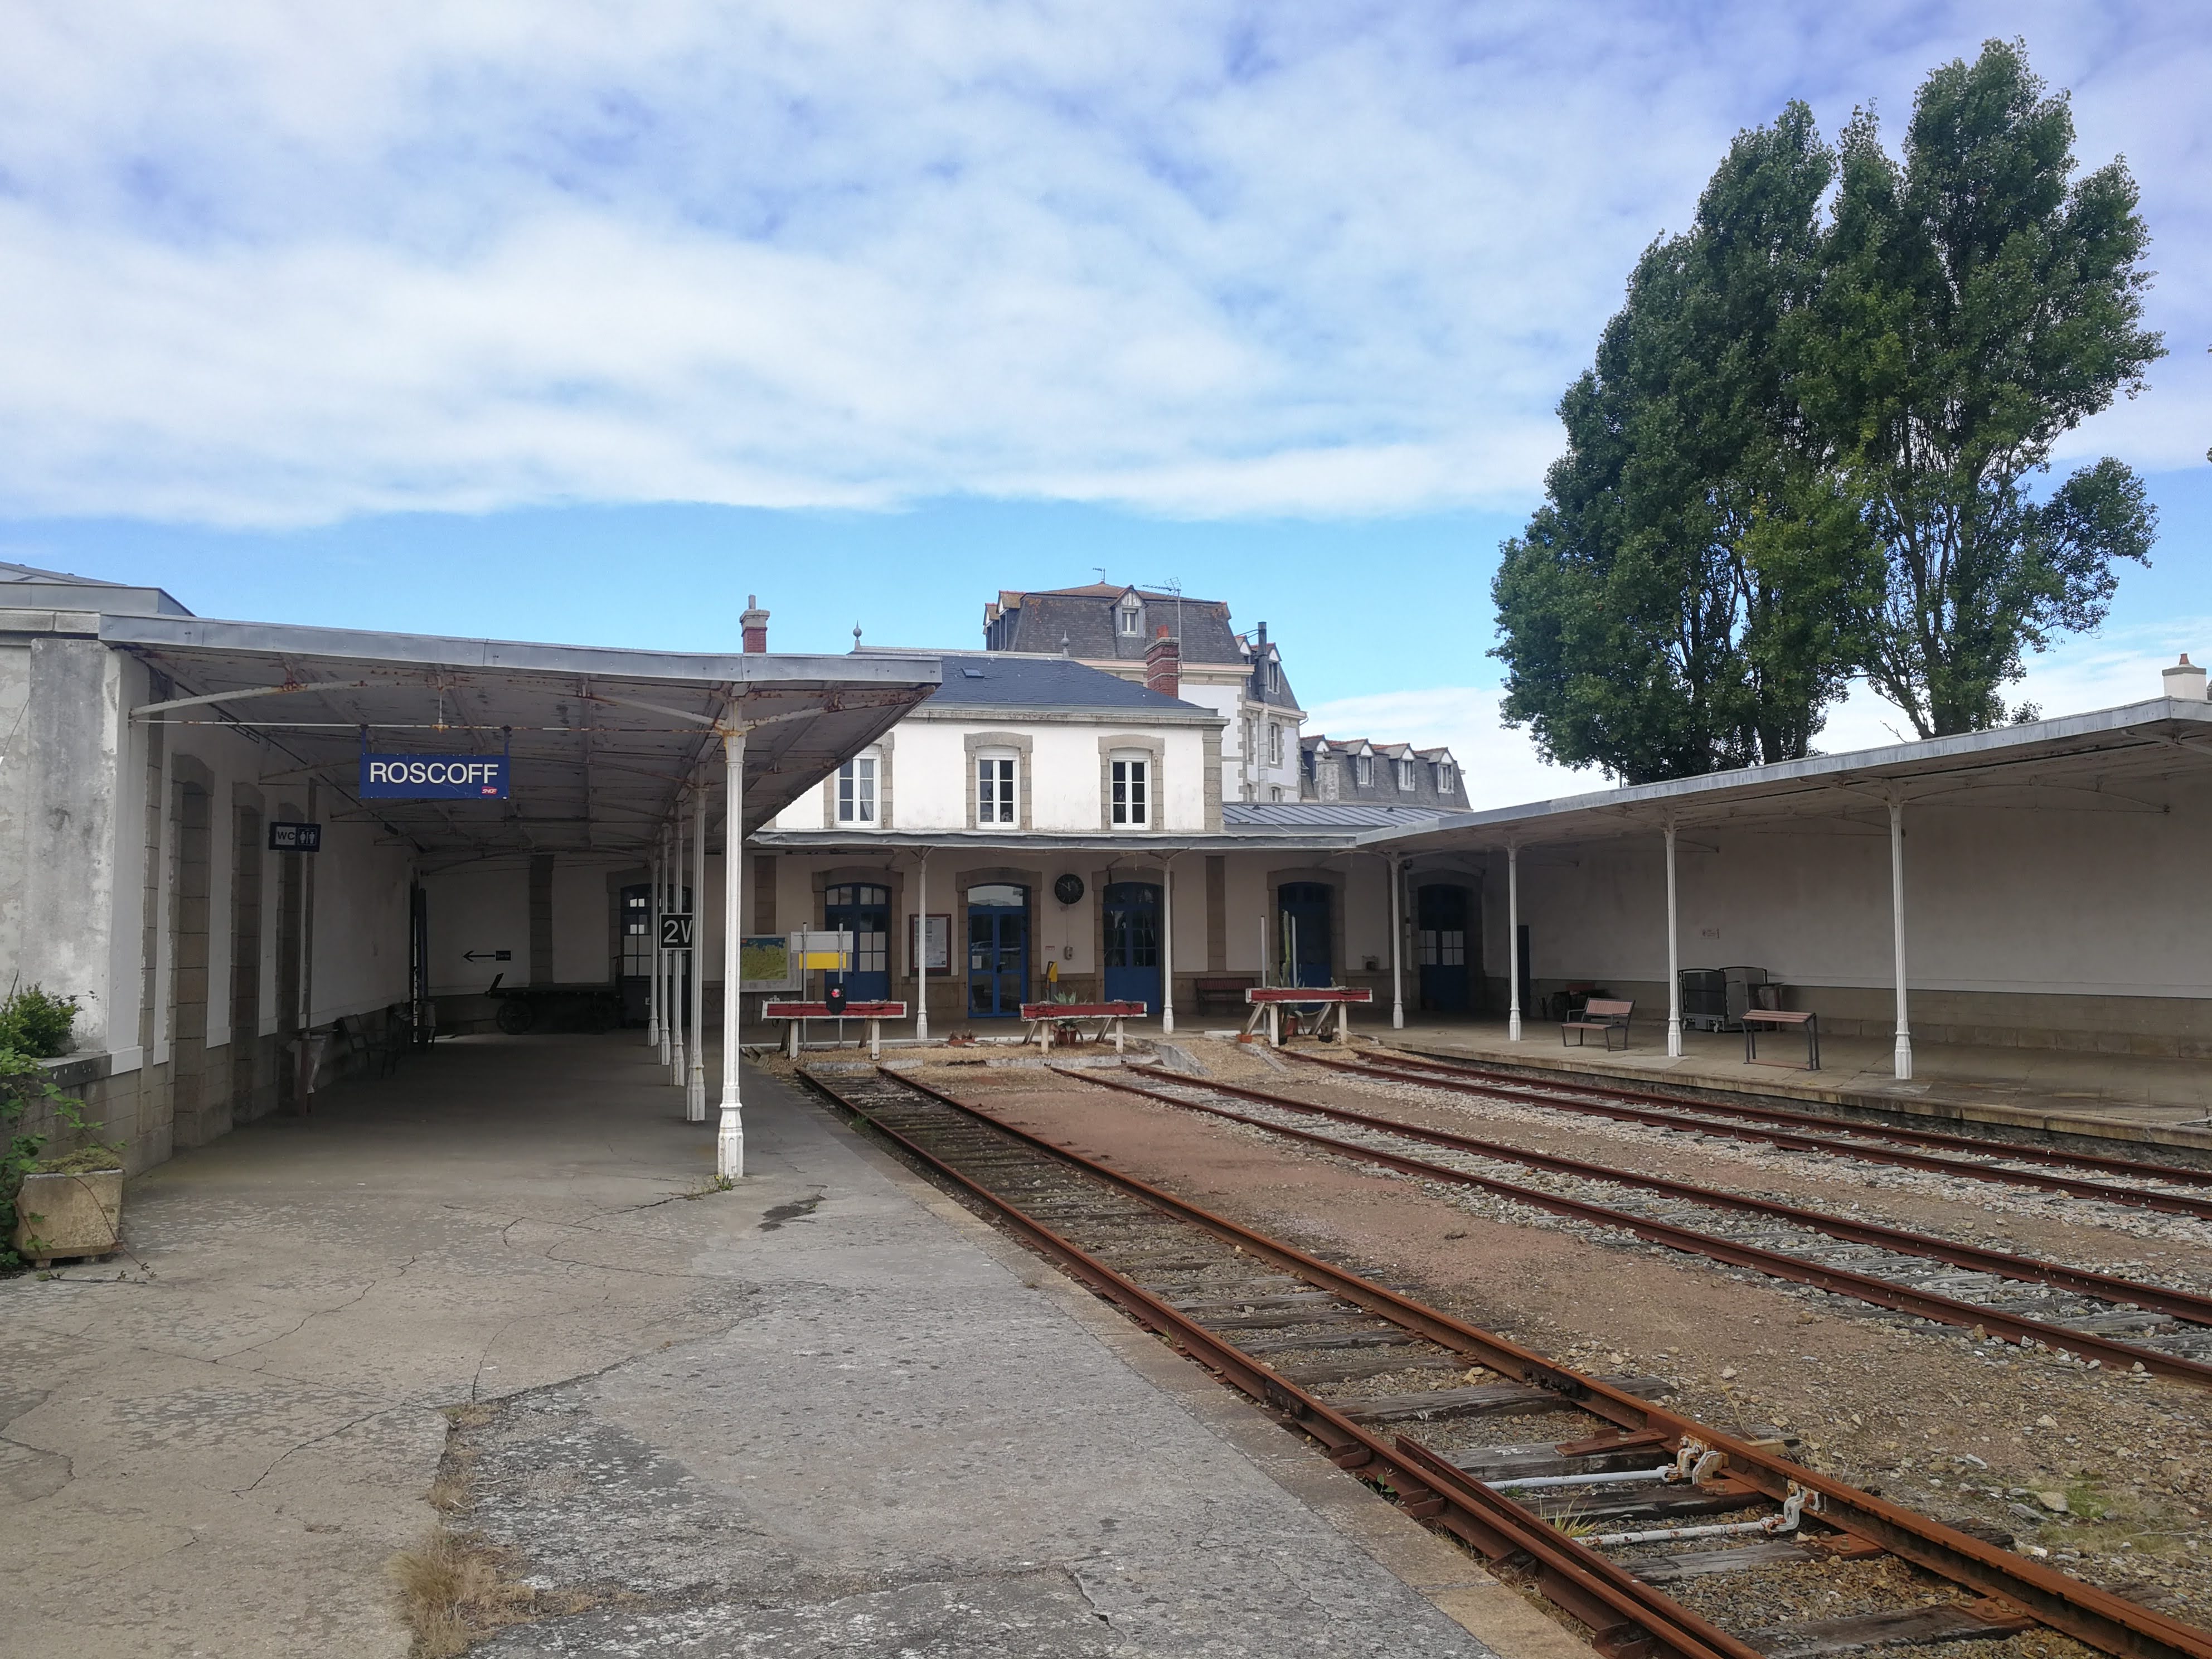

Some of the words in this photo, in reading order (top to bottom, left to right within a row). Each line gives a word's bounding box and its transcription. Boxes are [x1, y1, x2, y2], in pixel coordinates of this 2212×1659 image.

[370, 762, 499, 784] ROSCOFF
[277, 831, 295, 840] WC
[663, 920, 693, 943] 2V
